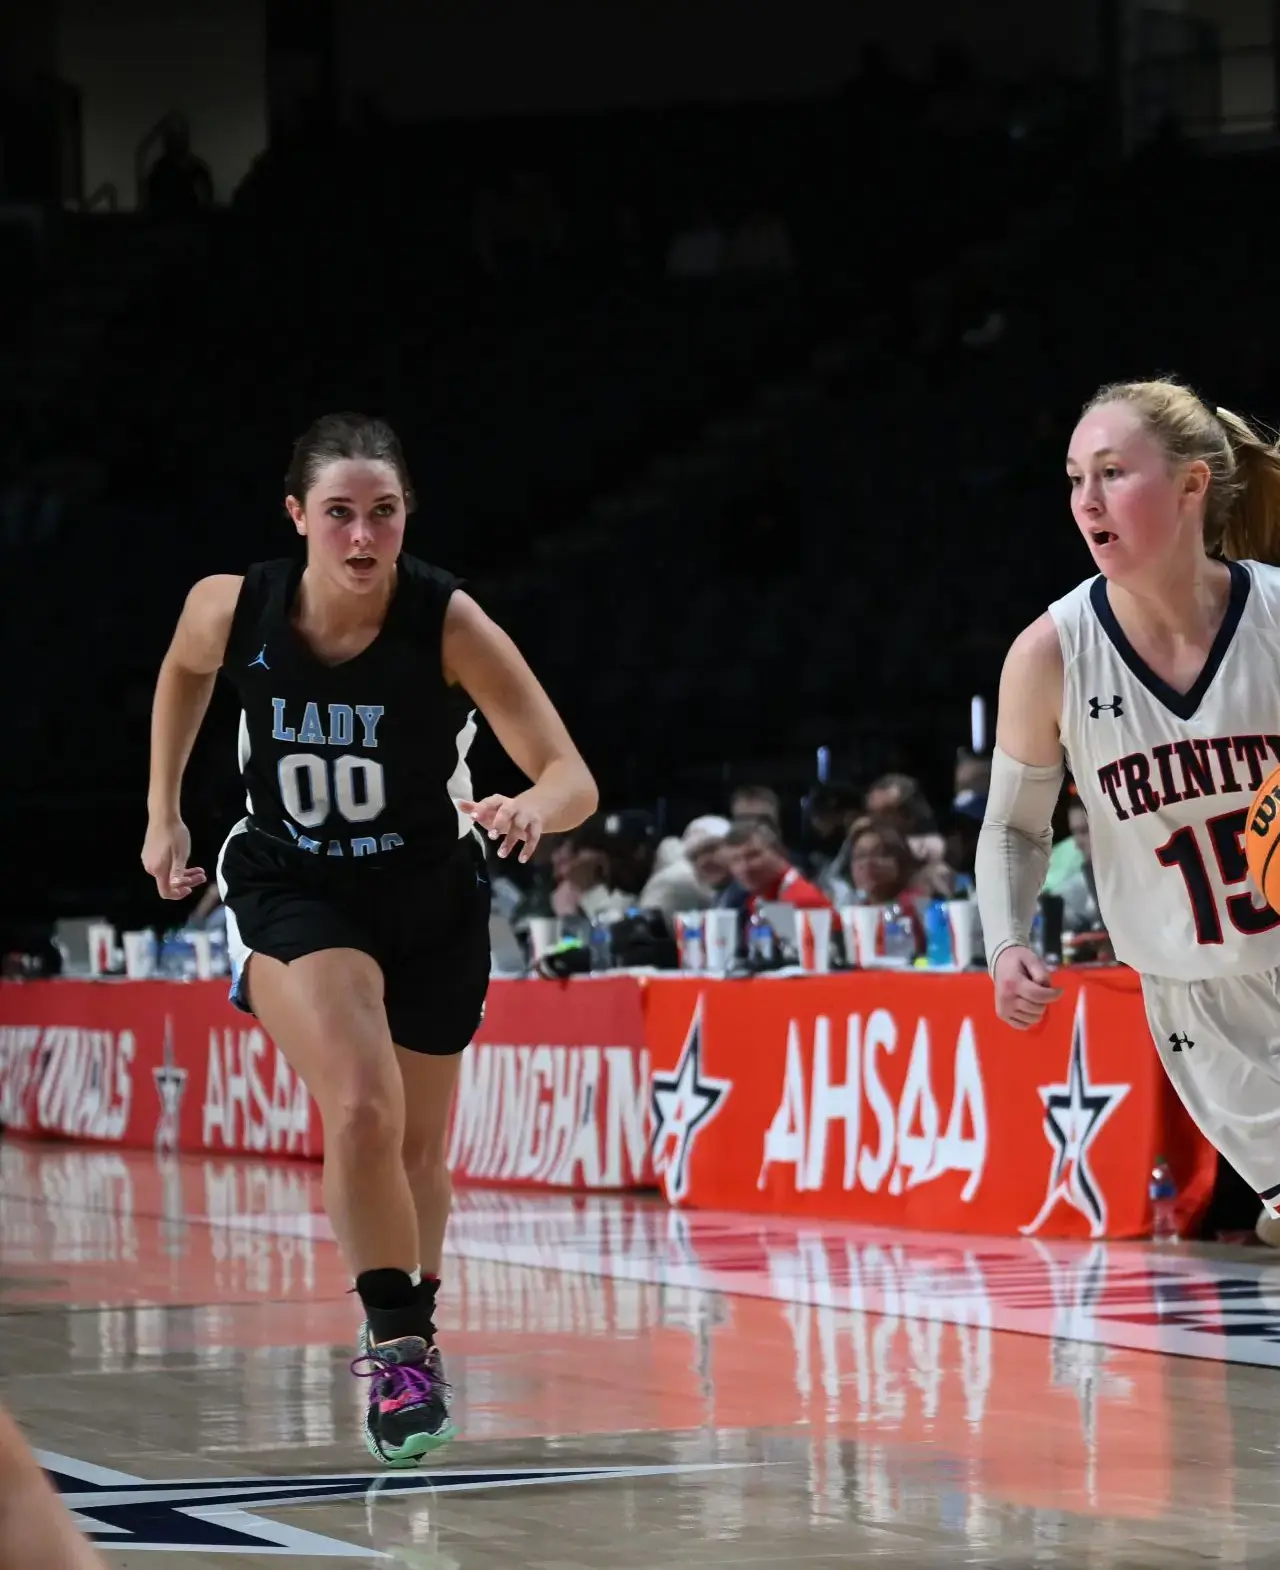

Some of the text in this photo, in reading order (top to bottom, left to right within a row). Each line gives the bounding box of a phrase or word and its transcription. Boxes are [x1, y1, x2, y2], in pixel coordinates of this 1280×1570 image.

[272, 698, 384, 747] LADY
[278, 753, 387, 828] 00
[202, 1026, 311, 1157] AHSAA
[757, 1008, 988, 1203] AHSAA
